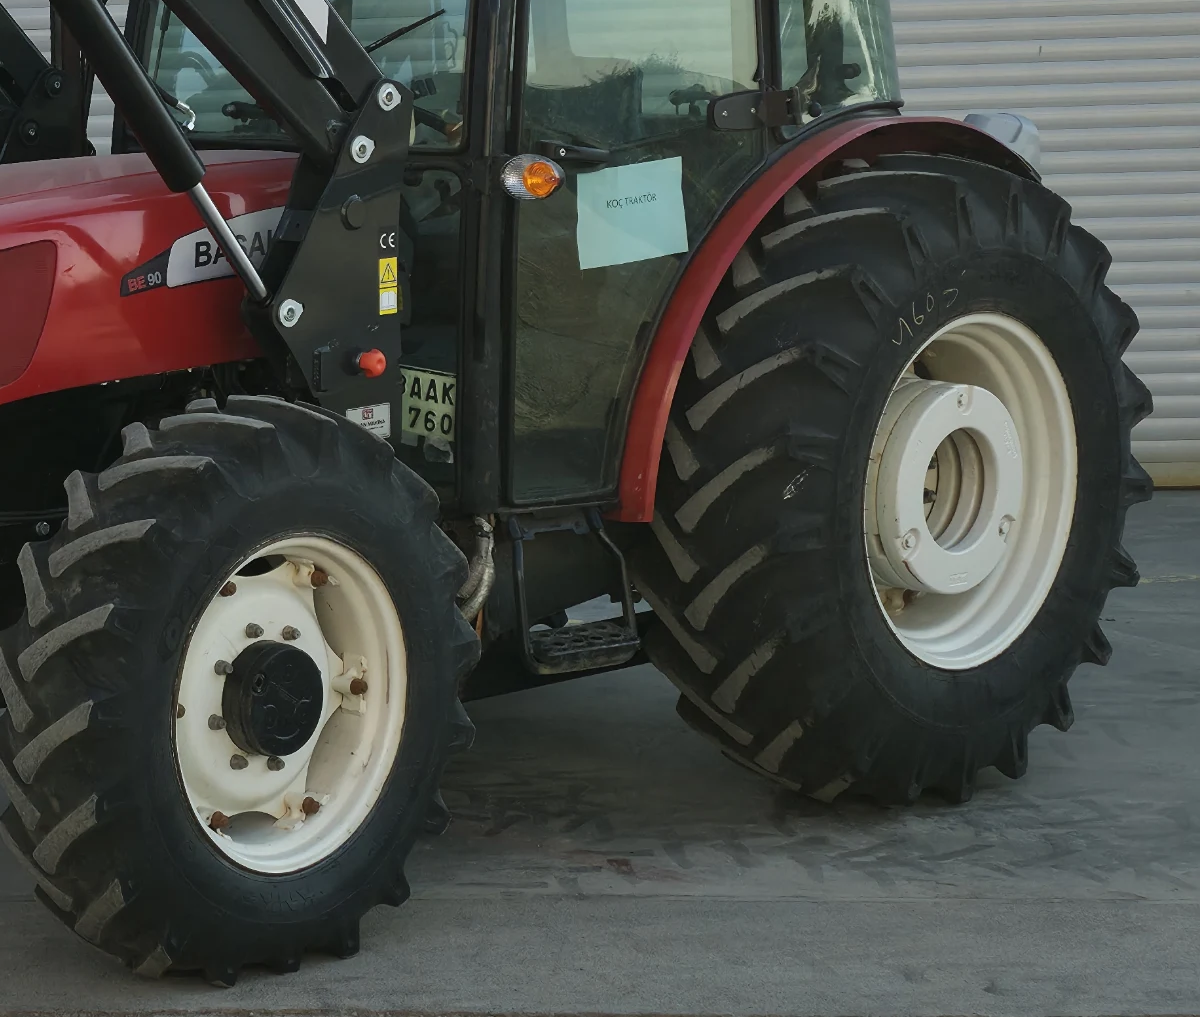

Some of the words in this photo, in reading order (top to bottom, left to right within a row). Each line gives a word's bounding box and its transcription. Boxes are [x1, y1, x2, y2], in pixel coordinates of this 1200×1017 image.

[606, 198, 623, 209] KOÇ
[624, 192, 657, 206] TRAKTÖR
[127, 275, 147, 292] BE
[147, 271, 162, 286] 90
[408, 407, 453, 436] 760
